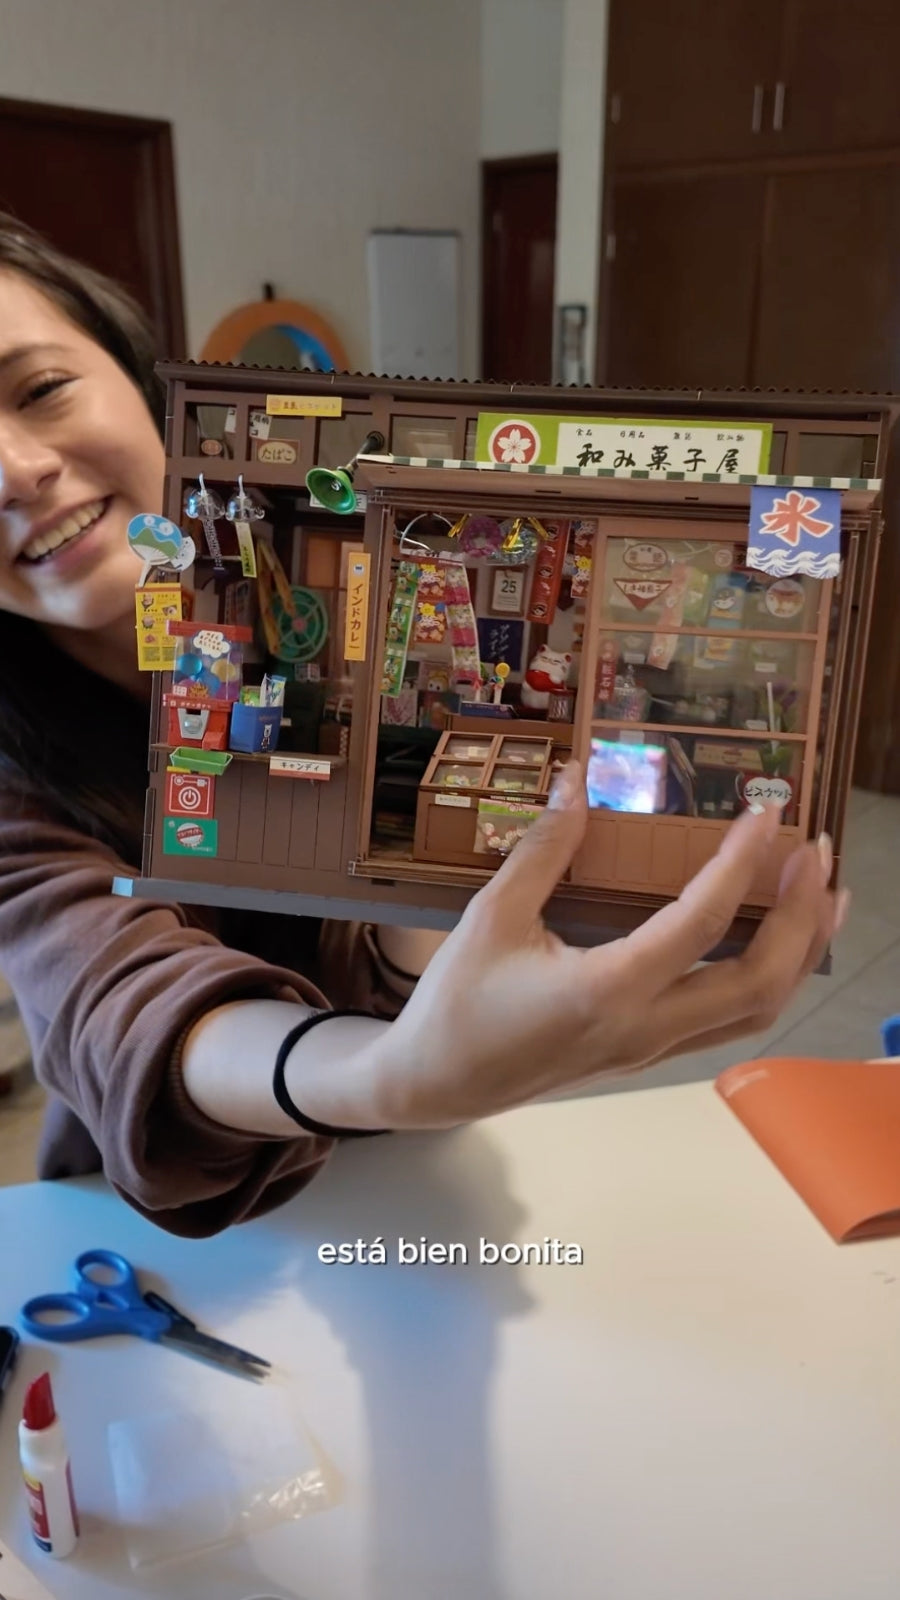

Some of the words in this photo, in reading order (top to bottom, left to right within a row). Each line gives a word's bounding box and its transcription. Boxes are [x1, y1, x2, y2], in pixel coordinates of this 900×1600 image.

[619, 430, 645, 439] 日用品
[262, 448, 293, 461] たばこ
[576, 443, 740, 474] 和み菓子屋
[760, 491, 833, 546] 氷
[501, 579, 517, 594] 25
[348, 583, 364, 649] インドカレー
[281, 761, 320, 771] キャンディ
[745, 786, 793, 800] ビスケット
